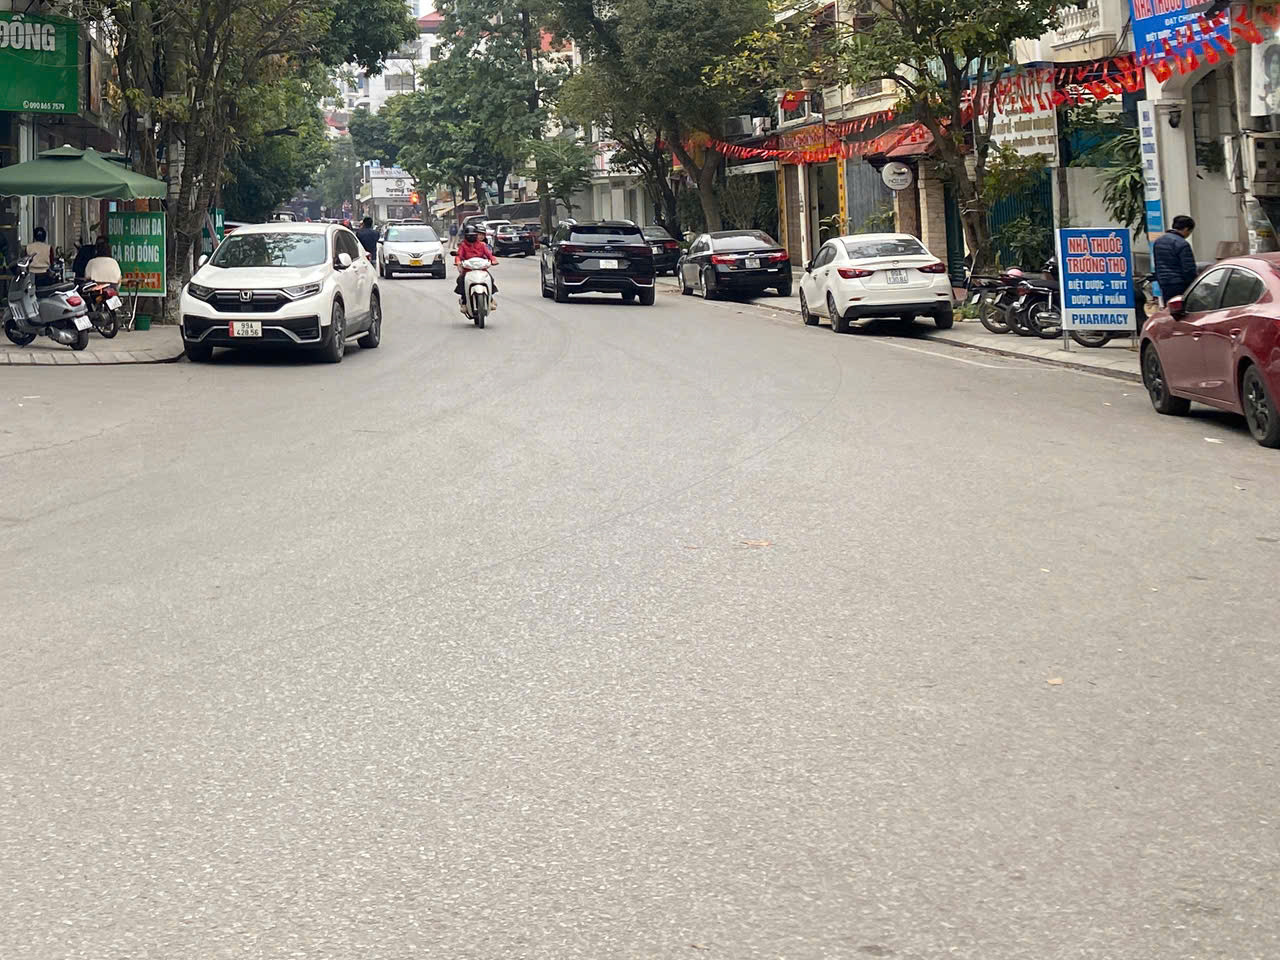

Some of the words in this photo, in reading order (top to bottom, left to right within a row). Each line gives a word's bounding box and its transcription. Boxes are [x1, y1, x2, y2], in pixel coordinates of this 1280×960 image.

[108, 215, 123, 235] BÚN
[130, 216, 150, 235] BÁNH
[1067, 234, 1089, 254] NHÀ
[1091, 232, 1123, 254] THUỐC
[1106, 257, 1127, 277] THỌ
[1072, 313, 1129, 325] PHARMACY
